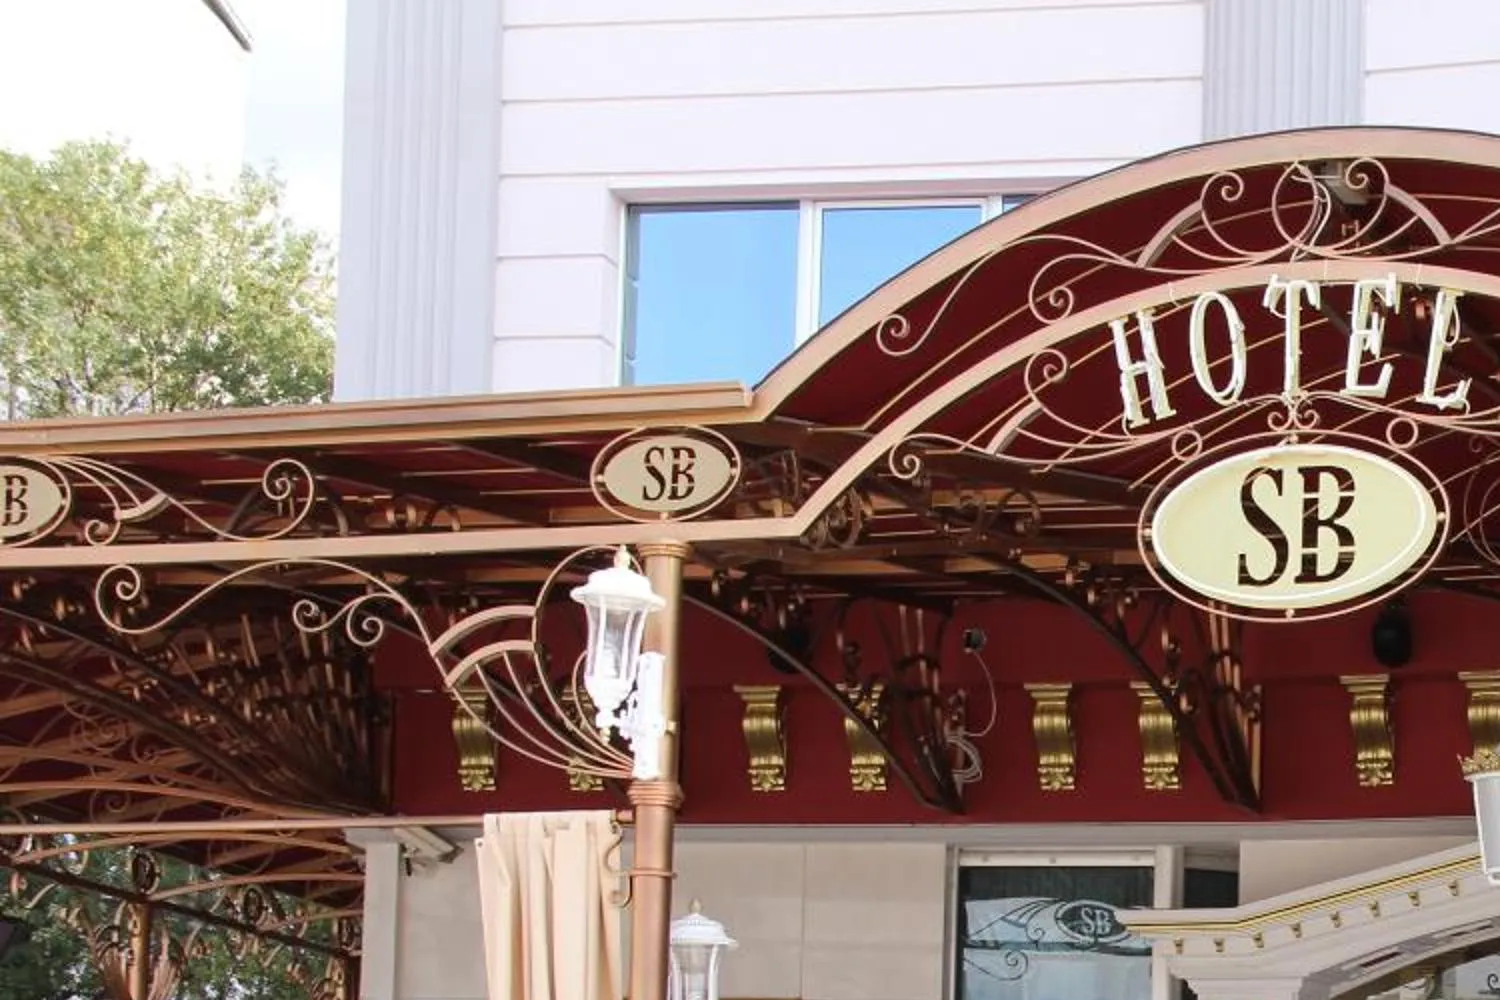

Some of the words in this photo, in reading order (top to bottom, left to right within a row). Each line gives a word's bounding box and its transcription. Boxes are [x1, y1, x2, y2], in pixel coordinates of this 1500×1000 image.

[1109, 273, 1472, 428] HOTEL
[641, 446, 697, 501] SB
[1236, 464, 1356, 588] SB
